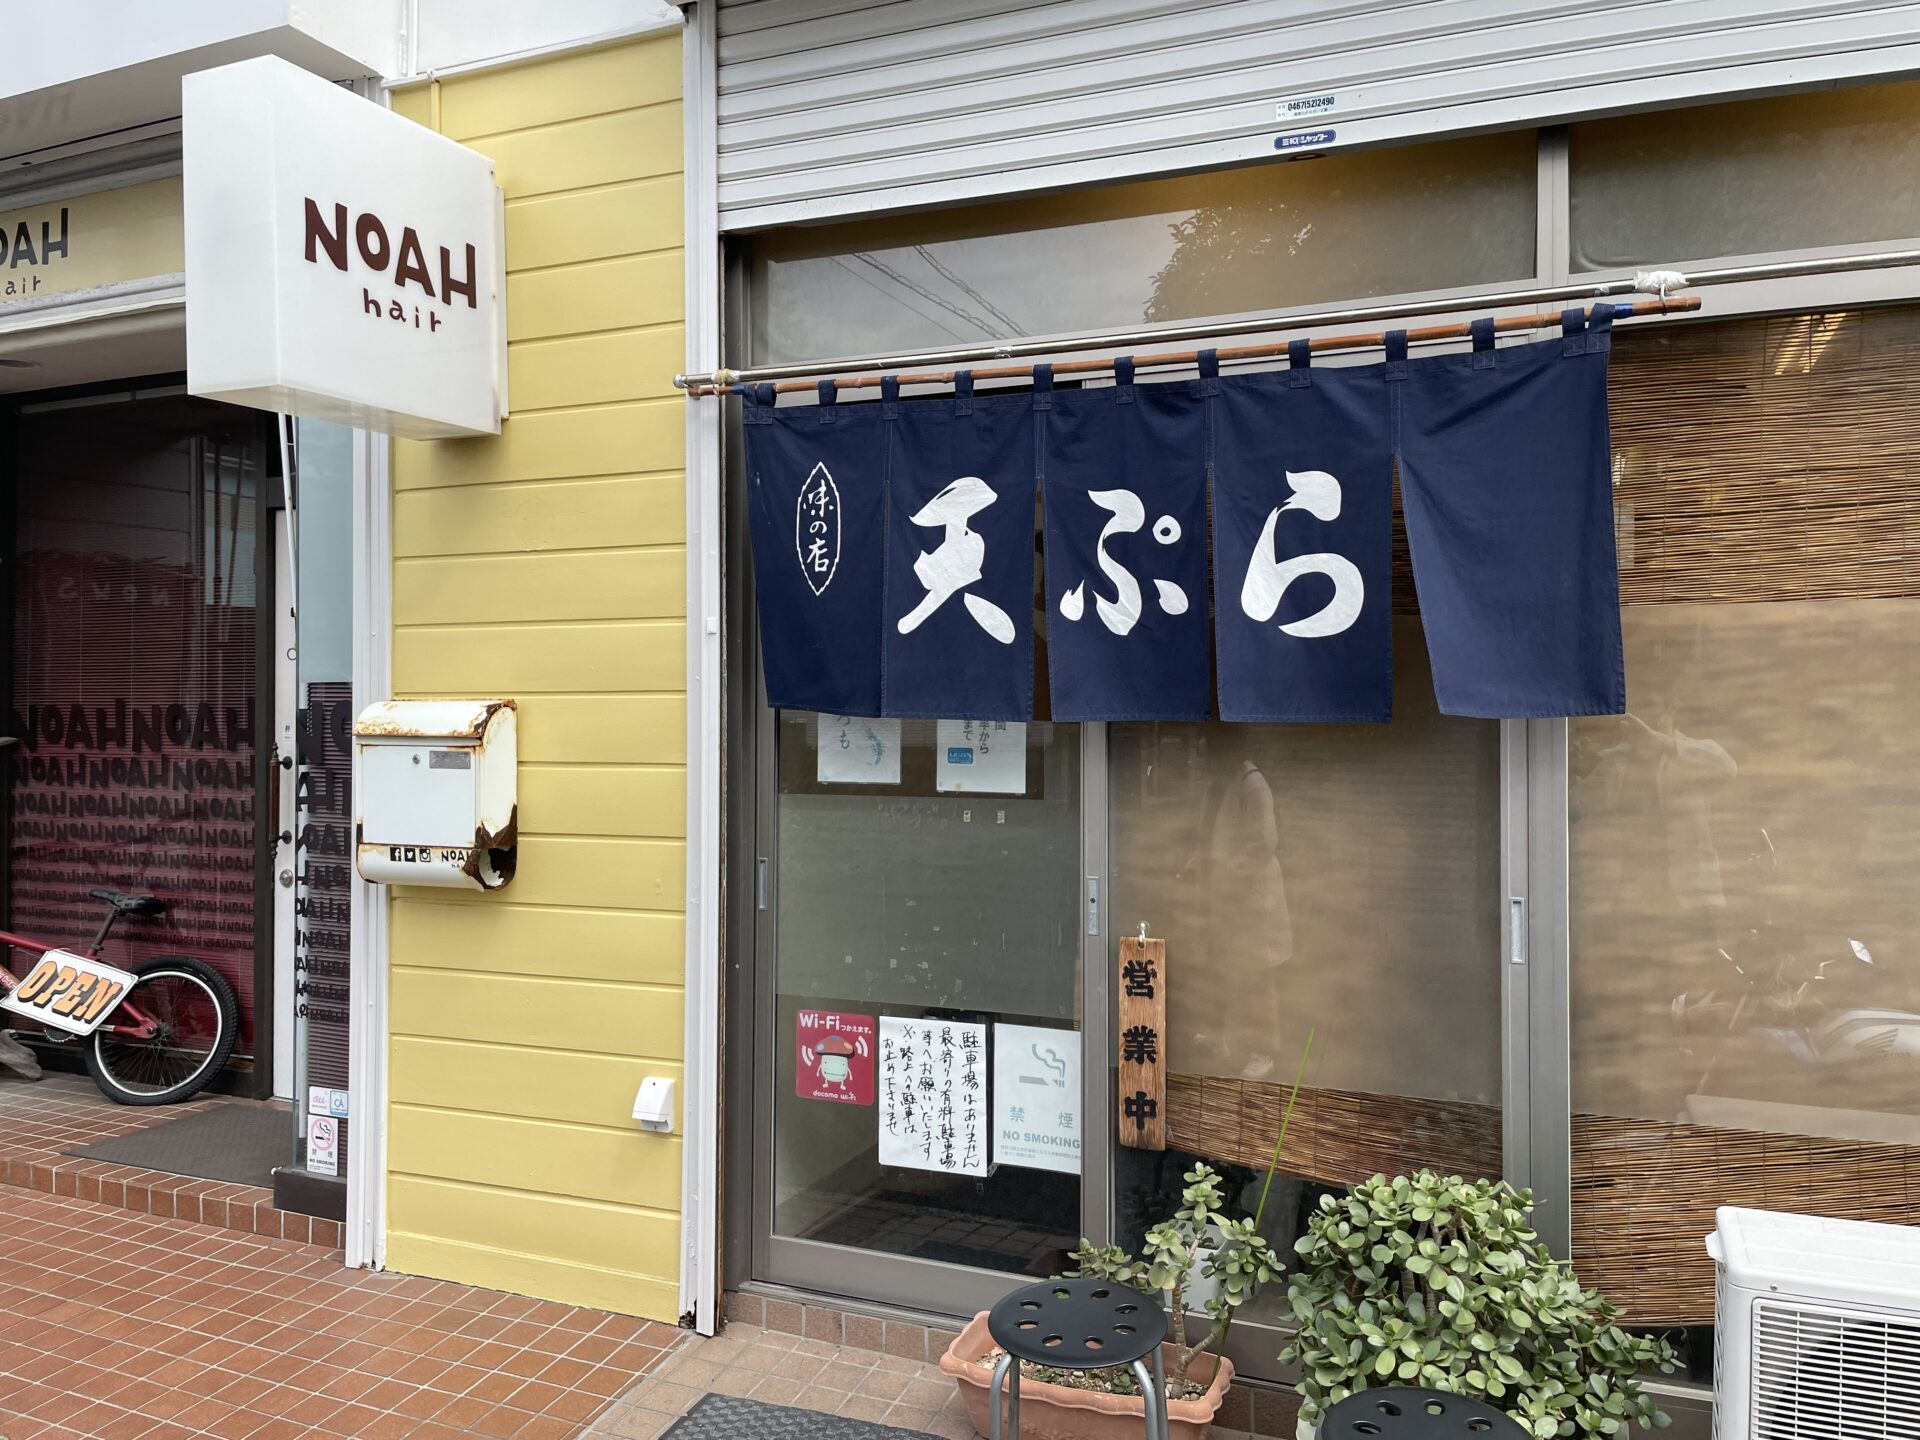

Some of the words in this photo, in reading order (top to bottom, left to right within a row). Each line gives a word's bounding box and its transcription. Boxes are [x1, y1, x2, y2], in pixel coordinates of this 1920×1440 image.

[304, 196, 478, 310] NOAH
[0, 275, 42, 296] air
[363, 287, 442, 333] hair
[802, 478, 835, 573] 味の店
[897, 469, 1365, 644] 天ぷら
[17, 960, 124, 1024] OPEN
[799, 1012, 840, 1031] Wi-Fi
[1122, 959, 1158, 1131] 営業中
[812, 1090, 839, 1099] docomo
[959, 1031, 981, 1168] 駐車場はありません
[1002, 1130, 1020, 1141] NO
[1023, 1132, 1080, 1149] SMOKING
